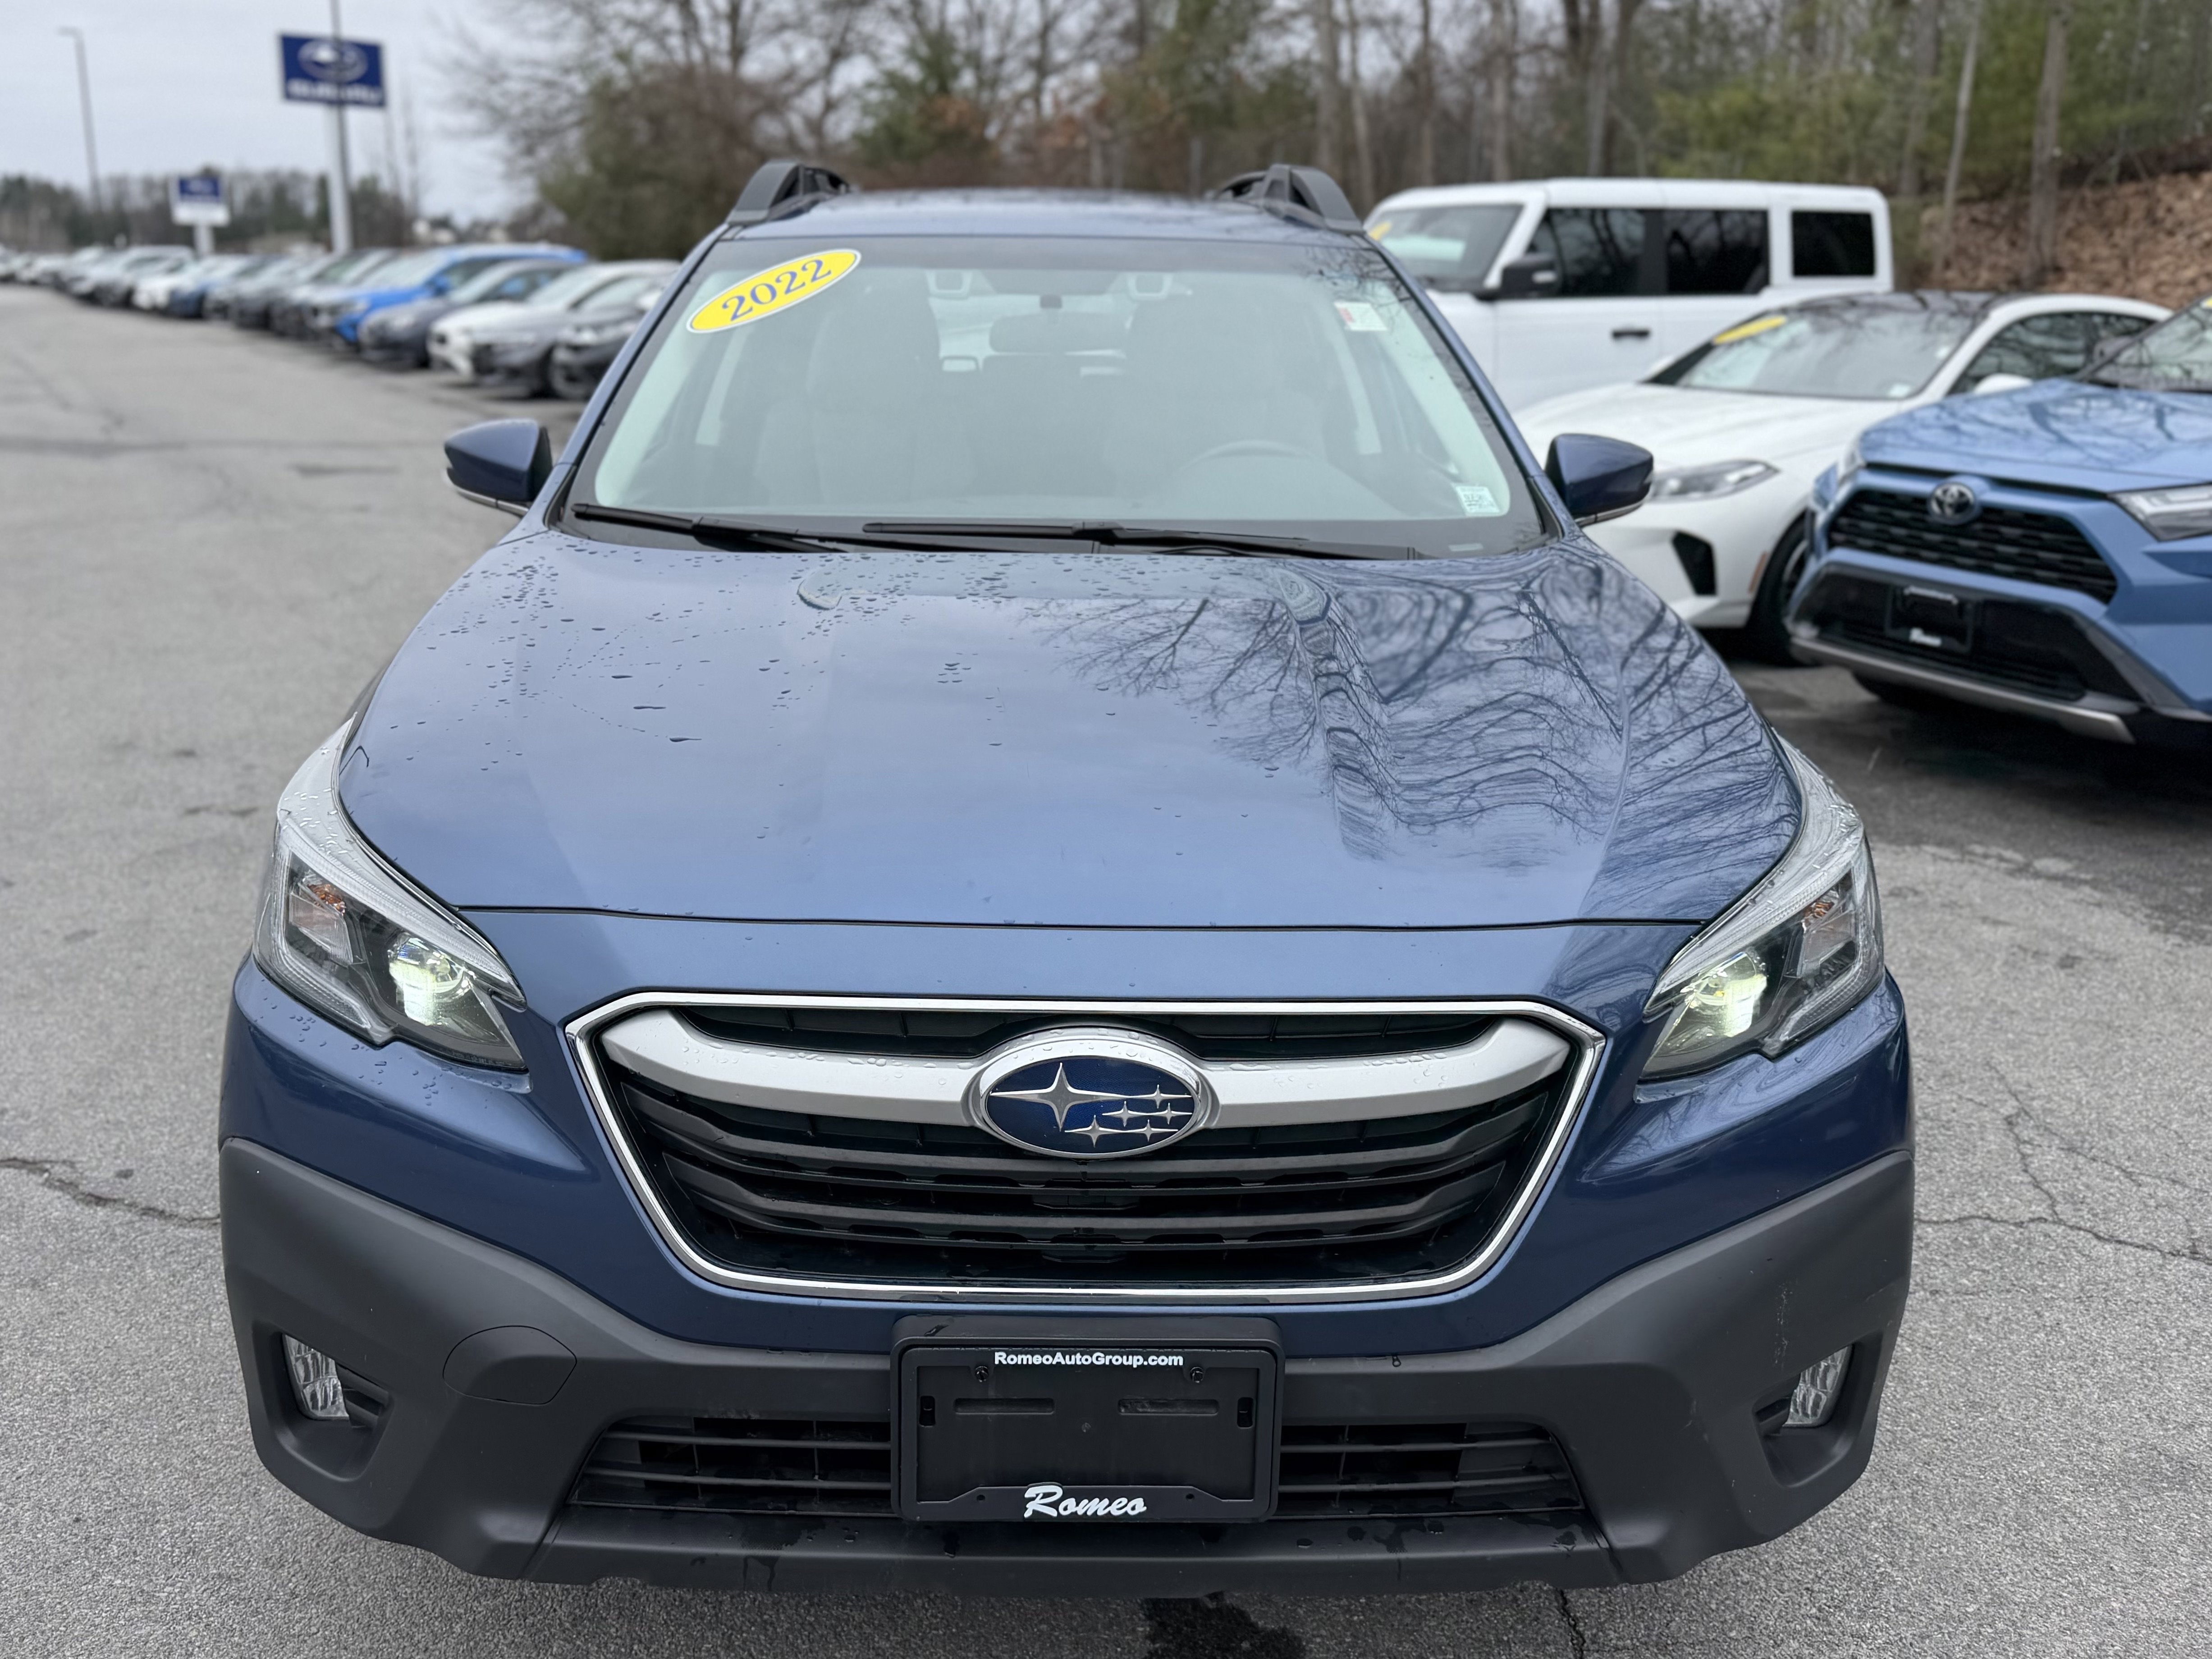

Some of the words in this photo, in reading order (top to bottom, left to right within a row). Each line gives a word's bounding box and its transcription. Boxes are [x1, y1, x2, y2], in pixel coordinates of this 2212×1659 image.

[722, 259, 832, 321] 2022
[994, 1352, 1183, 1368] RomeoAutoGroup.com
[1024, 1485, 1147, 1518] Romeo
